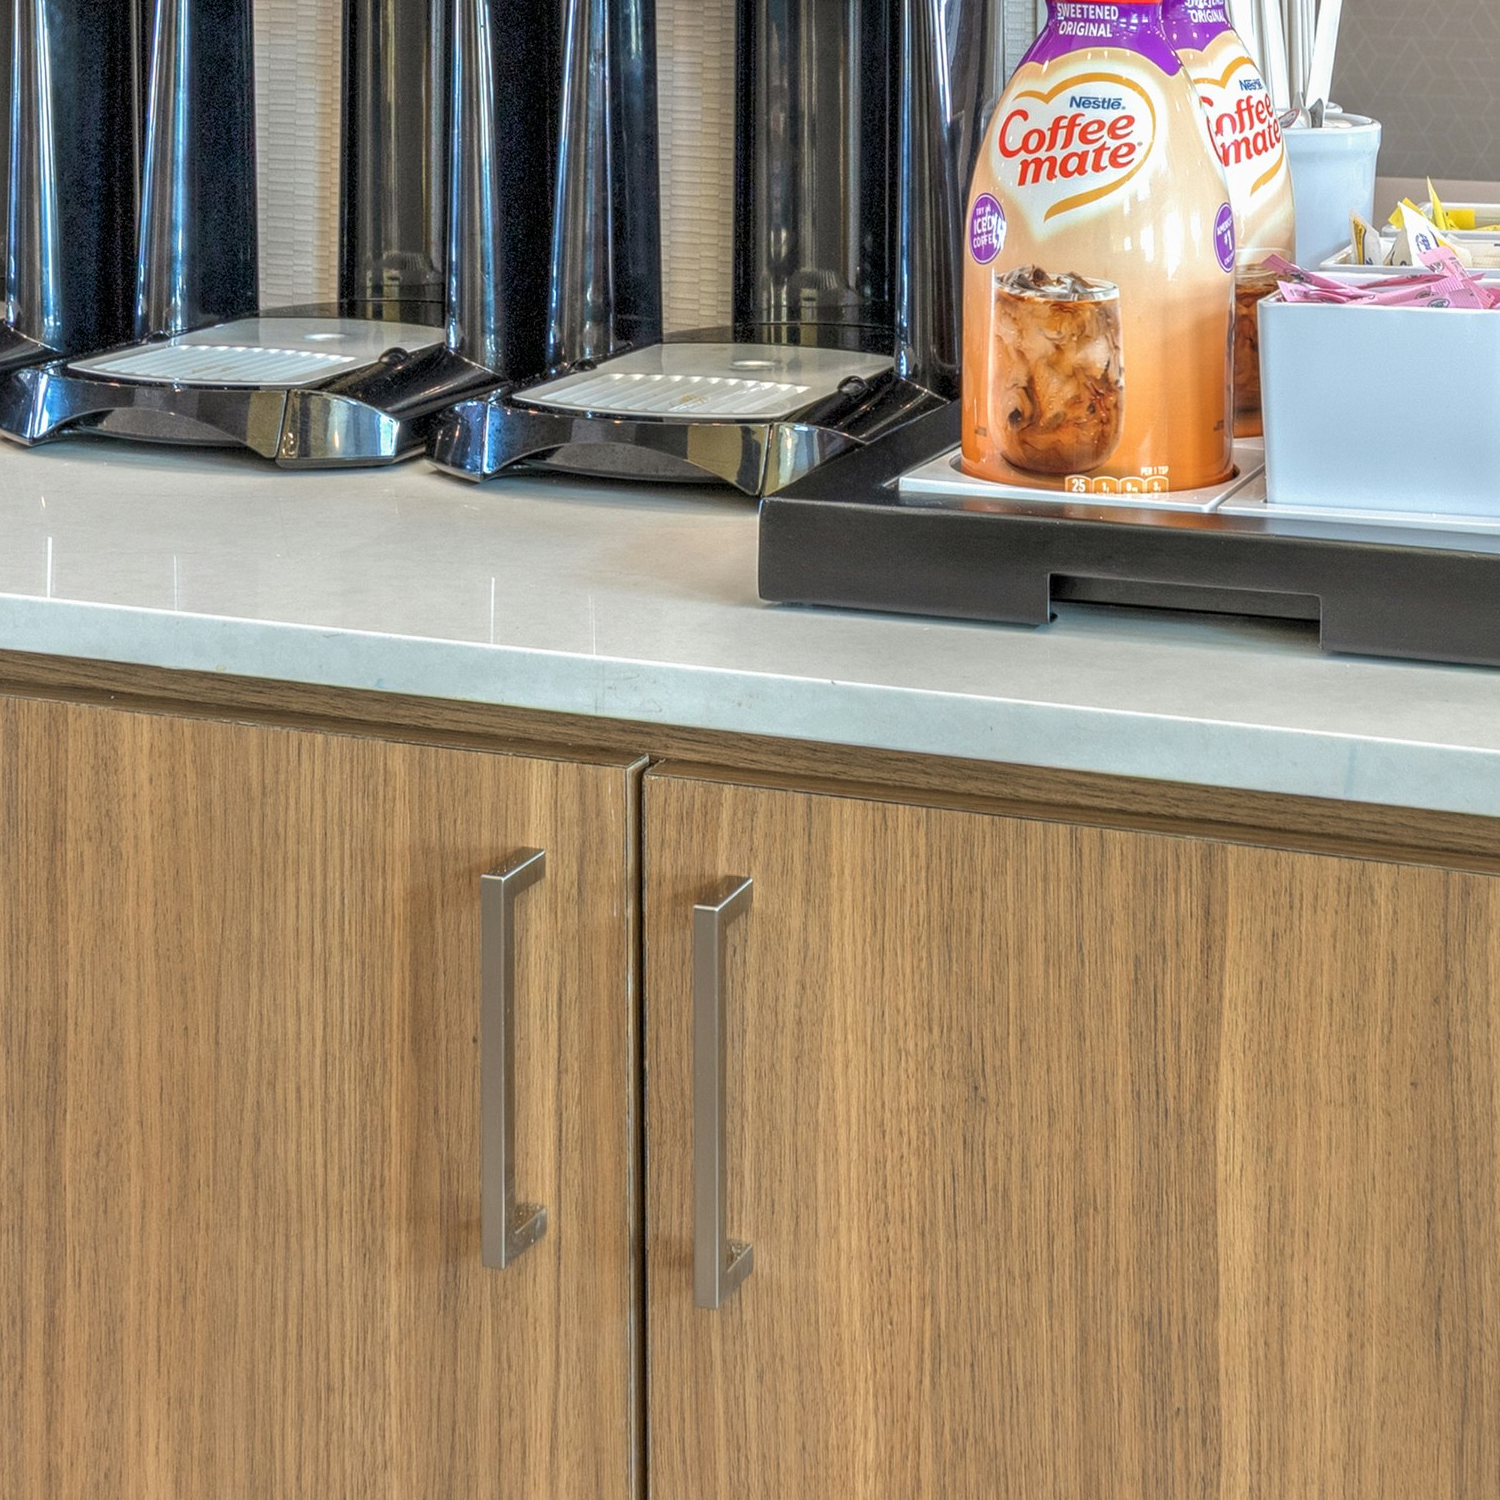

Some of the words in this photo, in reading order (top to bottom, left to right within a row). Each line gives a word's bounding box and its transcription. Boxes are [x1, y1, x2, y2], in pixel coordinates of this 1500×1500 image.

[1057, 2, 1119, 20] SWEETENED
[1059, 21, 1113, 38] ORIGINAL
[998, 108, 1136, 159] Coffee
[1220, 118, 1282, 168] mate
[1017, 141, 1137, 187] mate
[1071, 478, 1086, 493] 25
